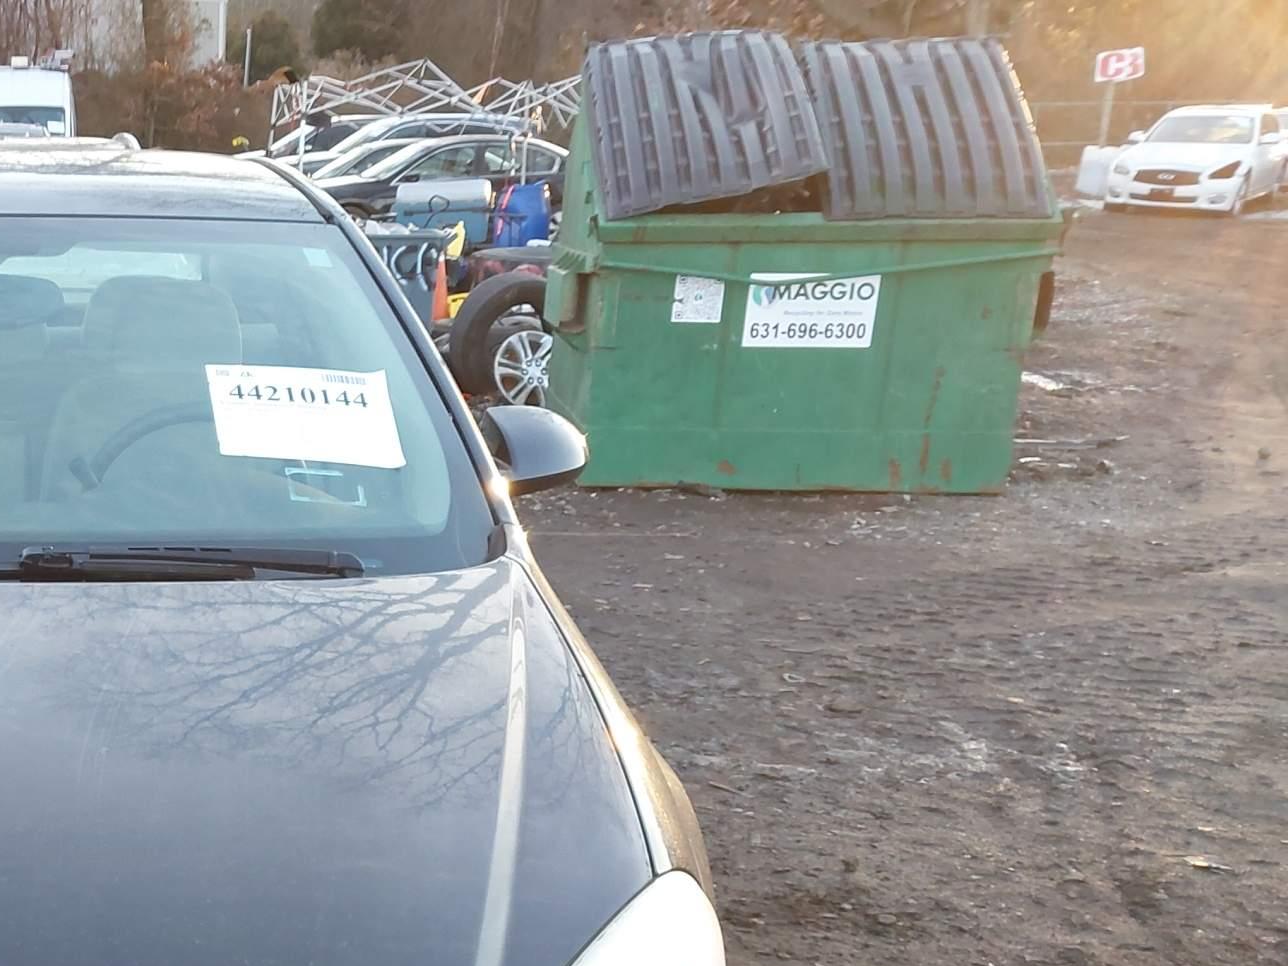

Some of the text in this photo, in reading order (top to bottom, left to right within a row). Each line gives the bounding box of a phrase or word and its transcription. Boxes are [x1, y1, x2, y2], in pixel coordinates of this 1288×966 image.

[772, 282, 875, 301] MAGGIO
[750, 322, 867, 339] 631-696-6300
[228, 383, 369, 408] 44210144
